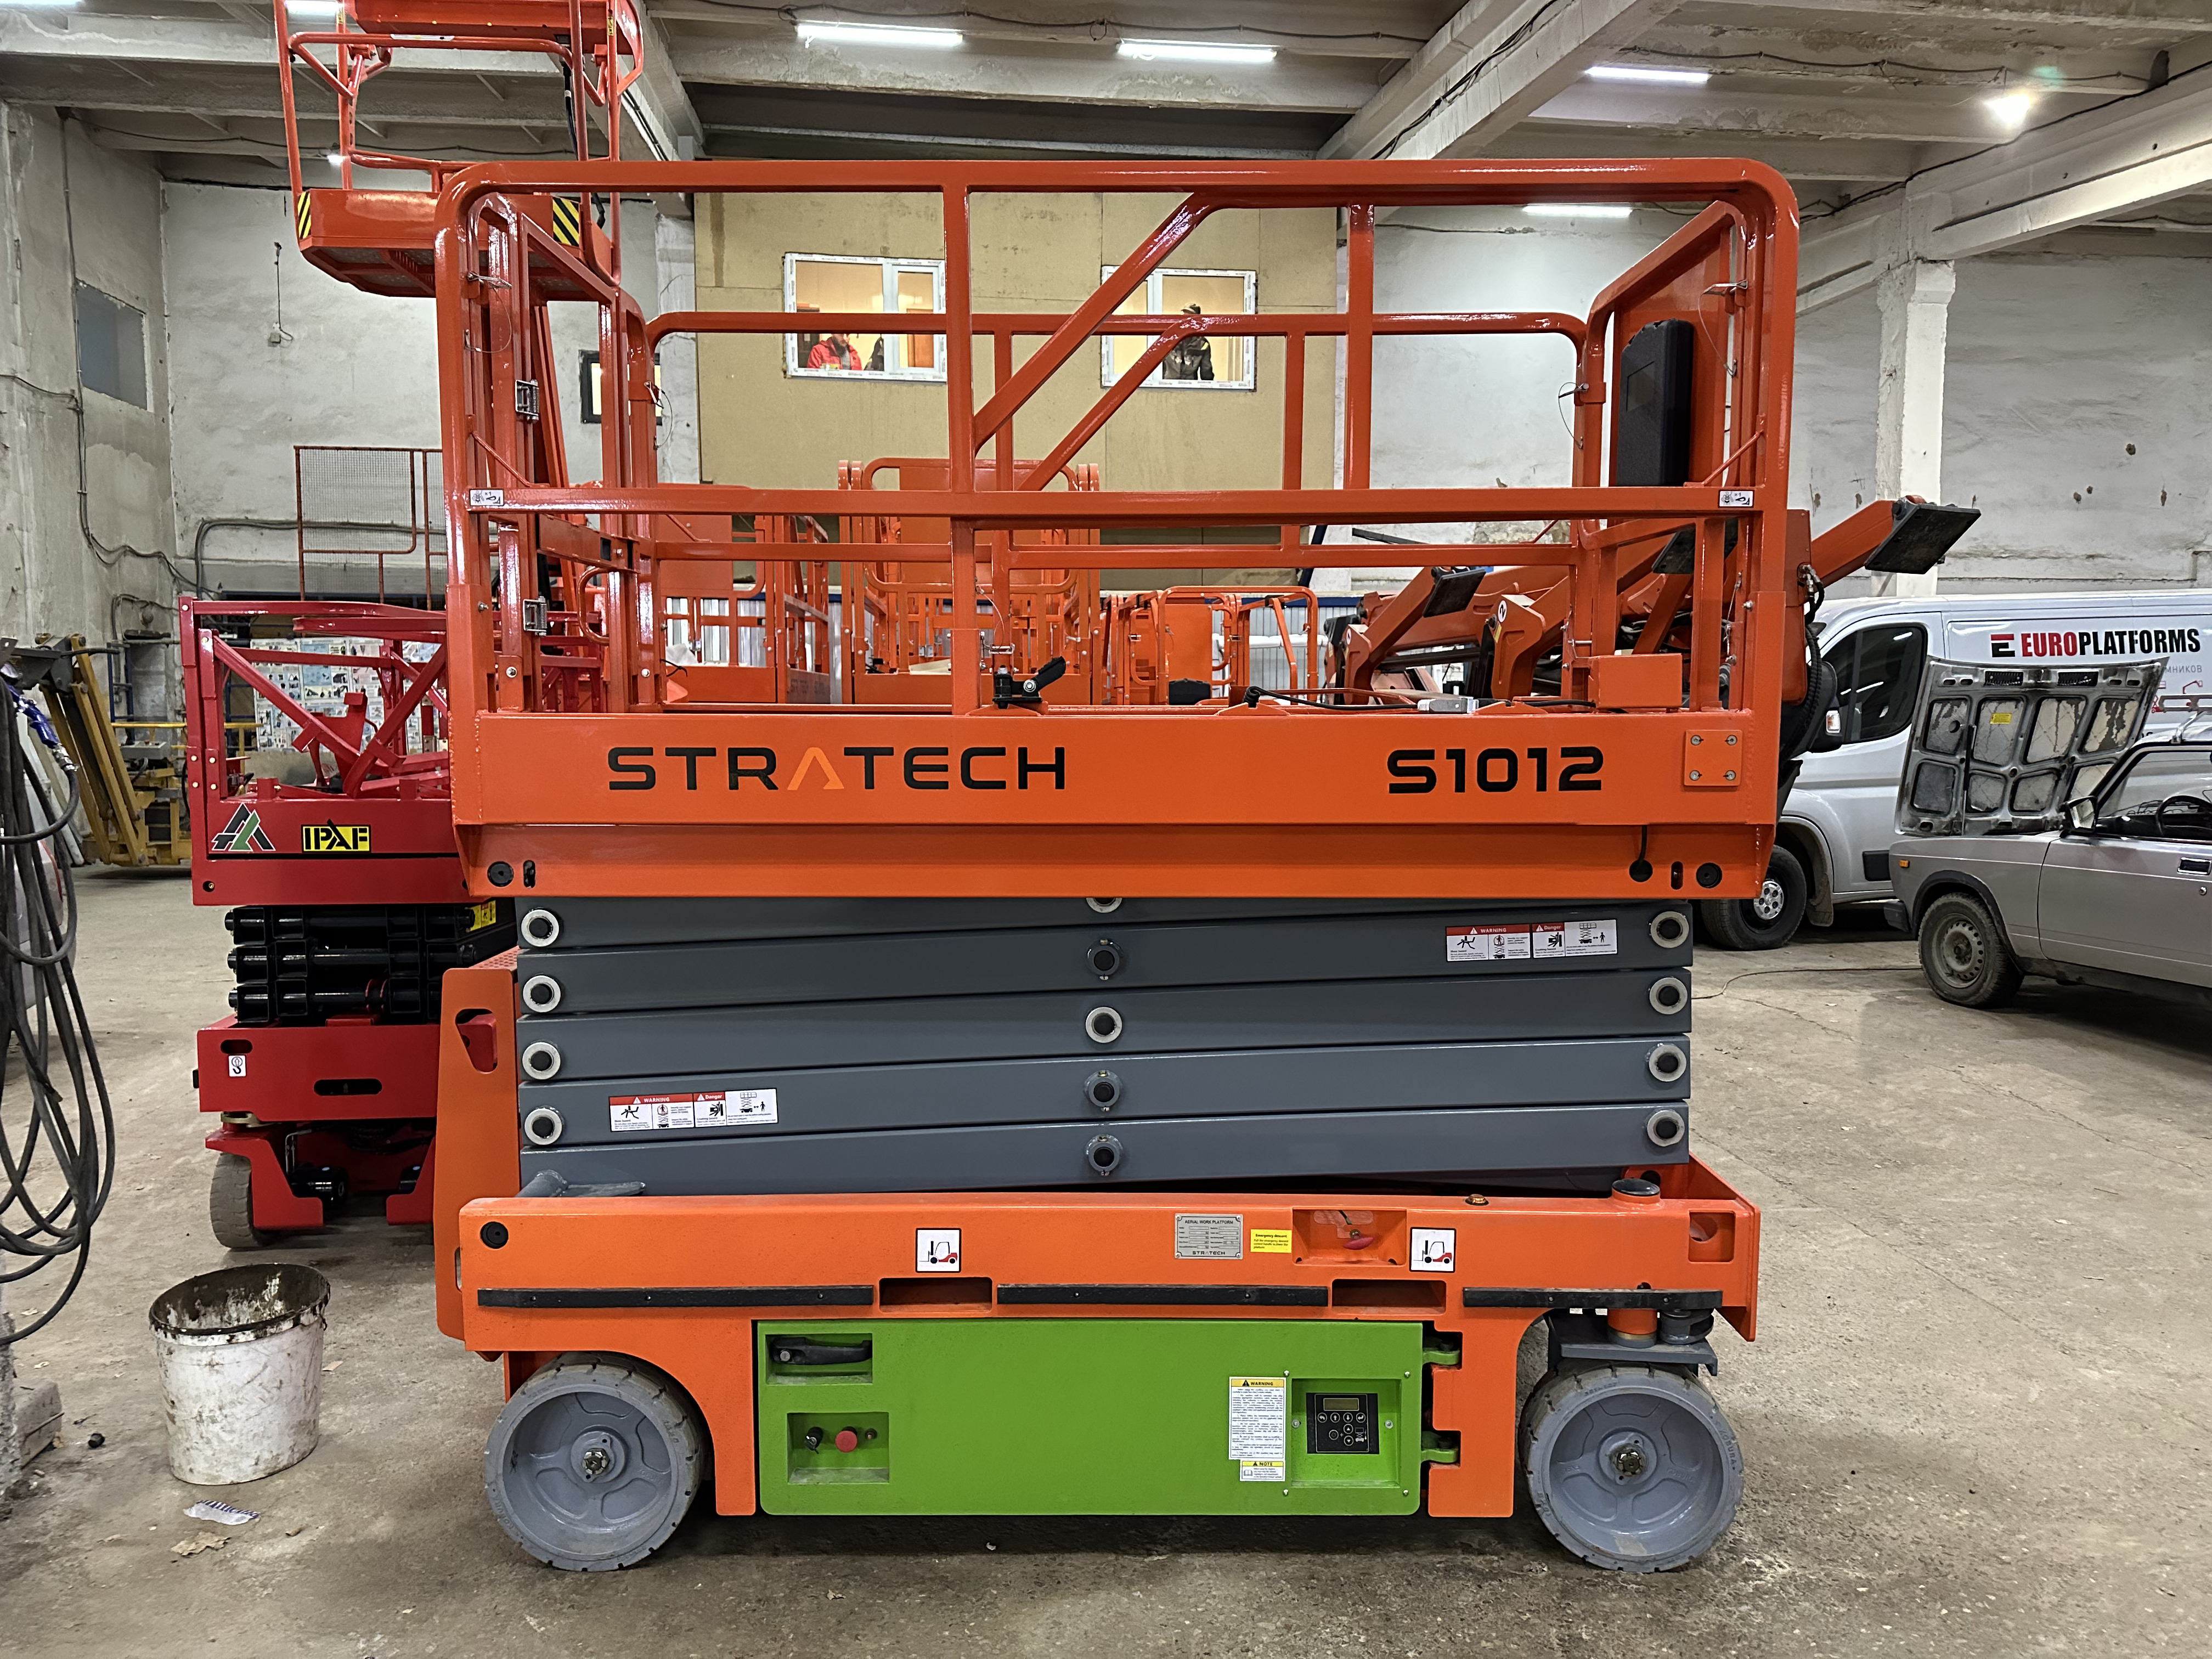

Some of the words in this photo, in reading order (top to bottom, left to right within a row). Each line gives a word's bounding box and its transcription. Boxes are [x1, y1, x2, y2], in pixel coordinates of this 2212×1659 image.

[2021, 628, 2201, 657] EUROPLATFORMS
[608, 747, 1065, 791] STRATECH
[1387, 746, 1604, 794] S1012
[304, 818, 368, 850] IPAF
